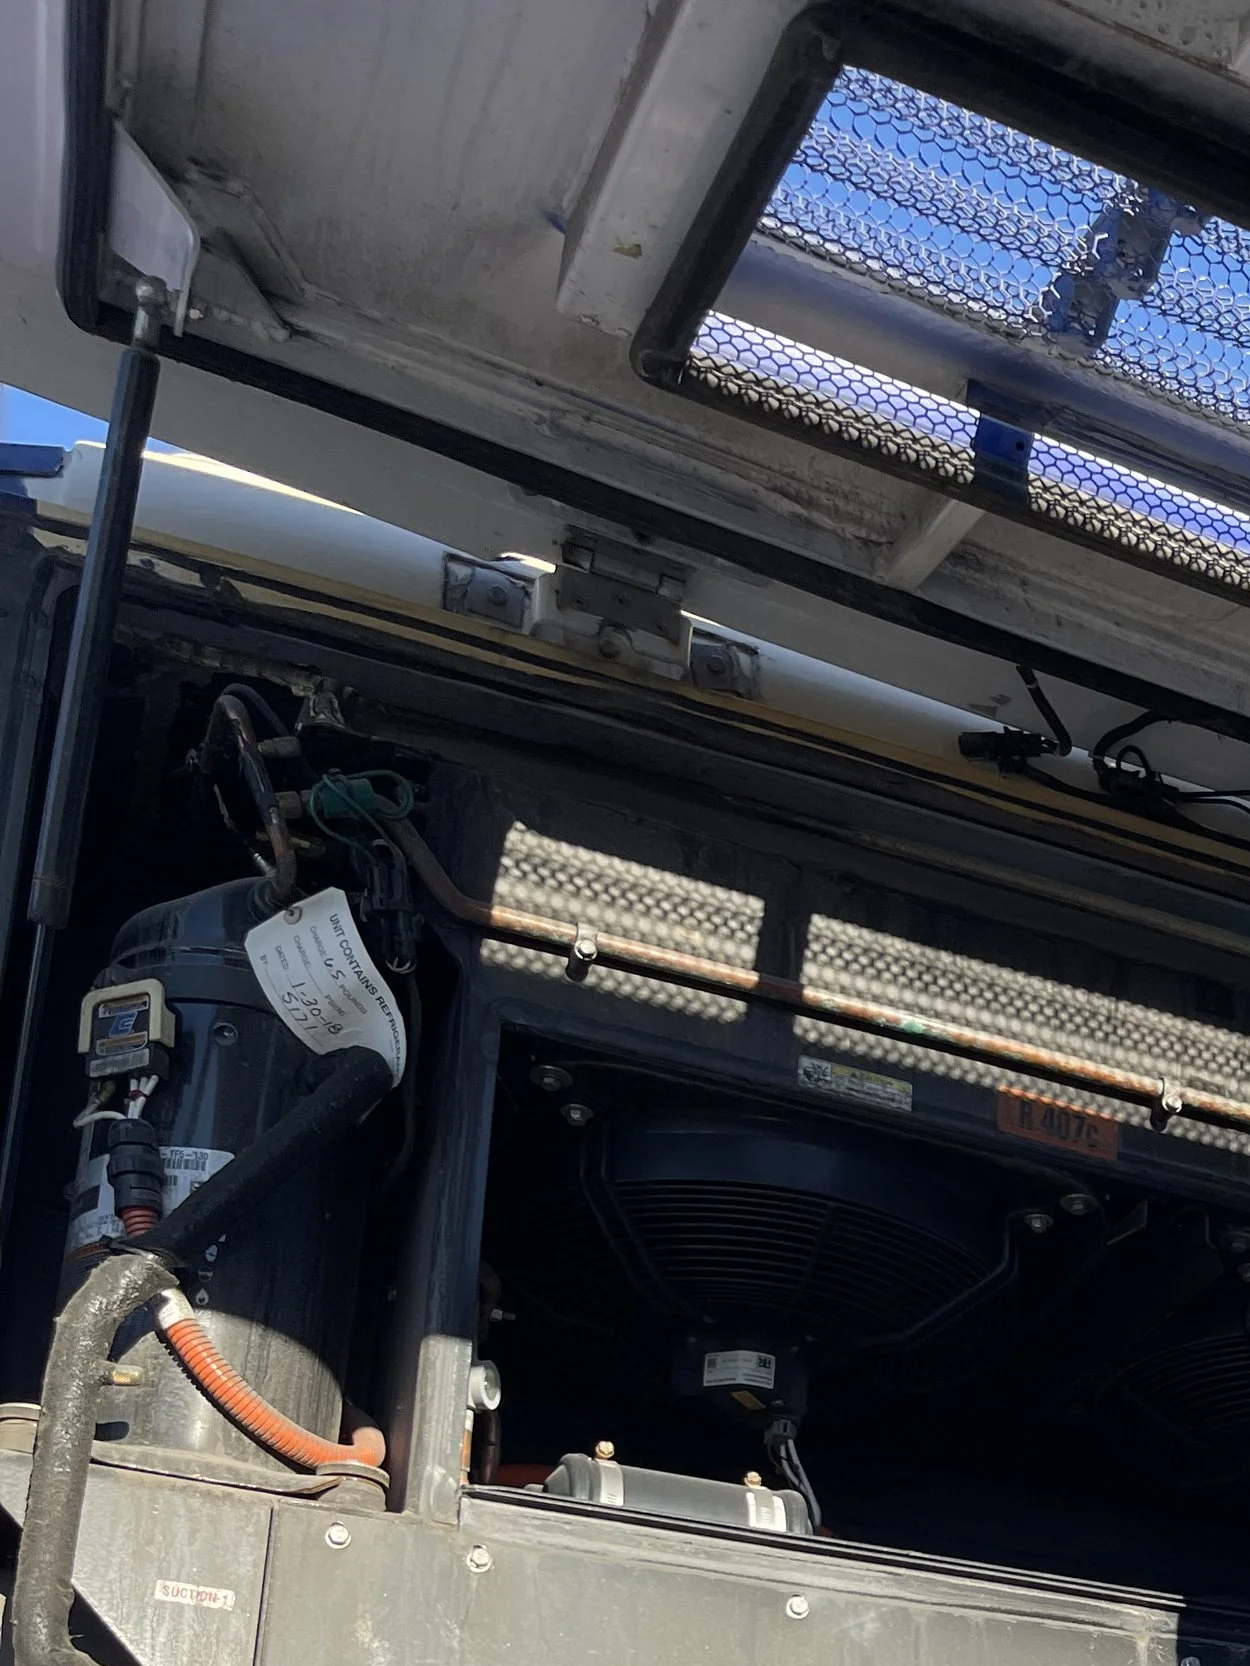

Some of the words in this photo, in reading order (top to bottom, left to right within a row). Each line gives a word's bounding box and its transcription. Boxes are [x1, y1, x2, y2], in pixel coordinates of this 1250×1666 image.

[329, 913, 346, 938] UNIT
[339, 939, 378, 996] CONTAINS
[375, 996, 401, 1072] REFRIGERA
